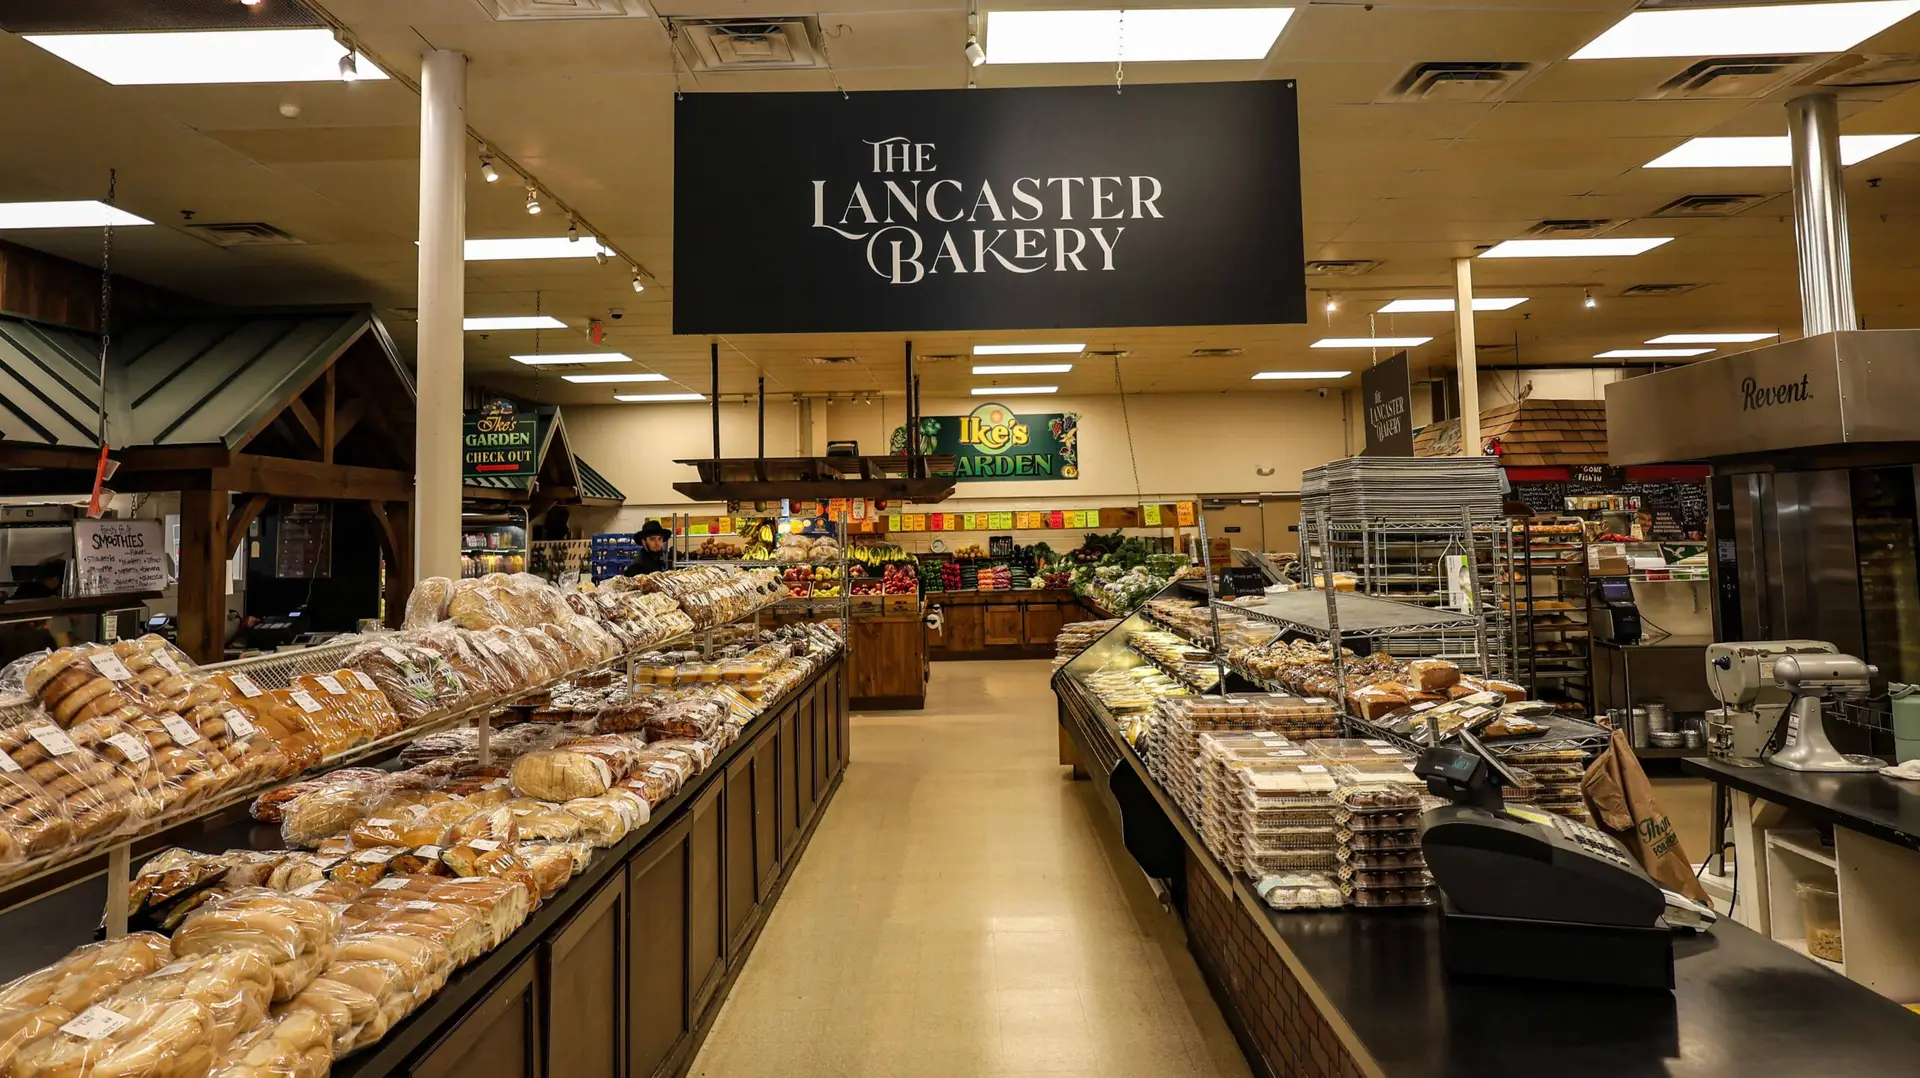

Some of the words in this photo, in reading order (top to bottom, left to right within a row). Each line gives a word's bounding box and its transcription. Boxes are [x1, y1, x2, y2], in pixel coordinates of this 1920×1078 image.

[863, 136, 937, 173] THE
[811, 175, 1164, 240] LANCASTER
[866, 225, 1125, 284] BAKERY
[1741, 373, 1809, 412] Revent
[476, 416, 518, 432] Ike's
[1369, 396, 1404, 428] LANCASTER
[465, 432, 530, 446] GARDEN
[959, 415, 1030, 449] Ike's
[1376, 416, 1401, 442] BAKERY
[465, 451, 505, 463] CHECK
[508, 450, 532, 462] OUT
[944, 453, 1053, 477] ARDEN
[92, 533, 144, 550] SMOOTHIES
